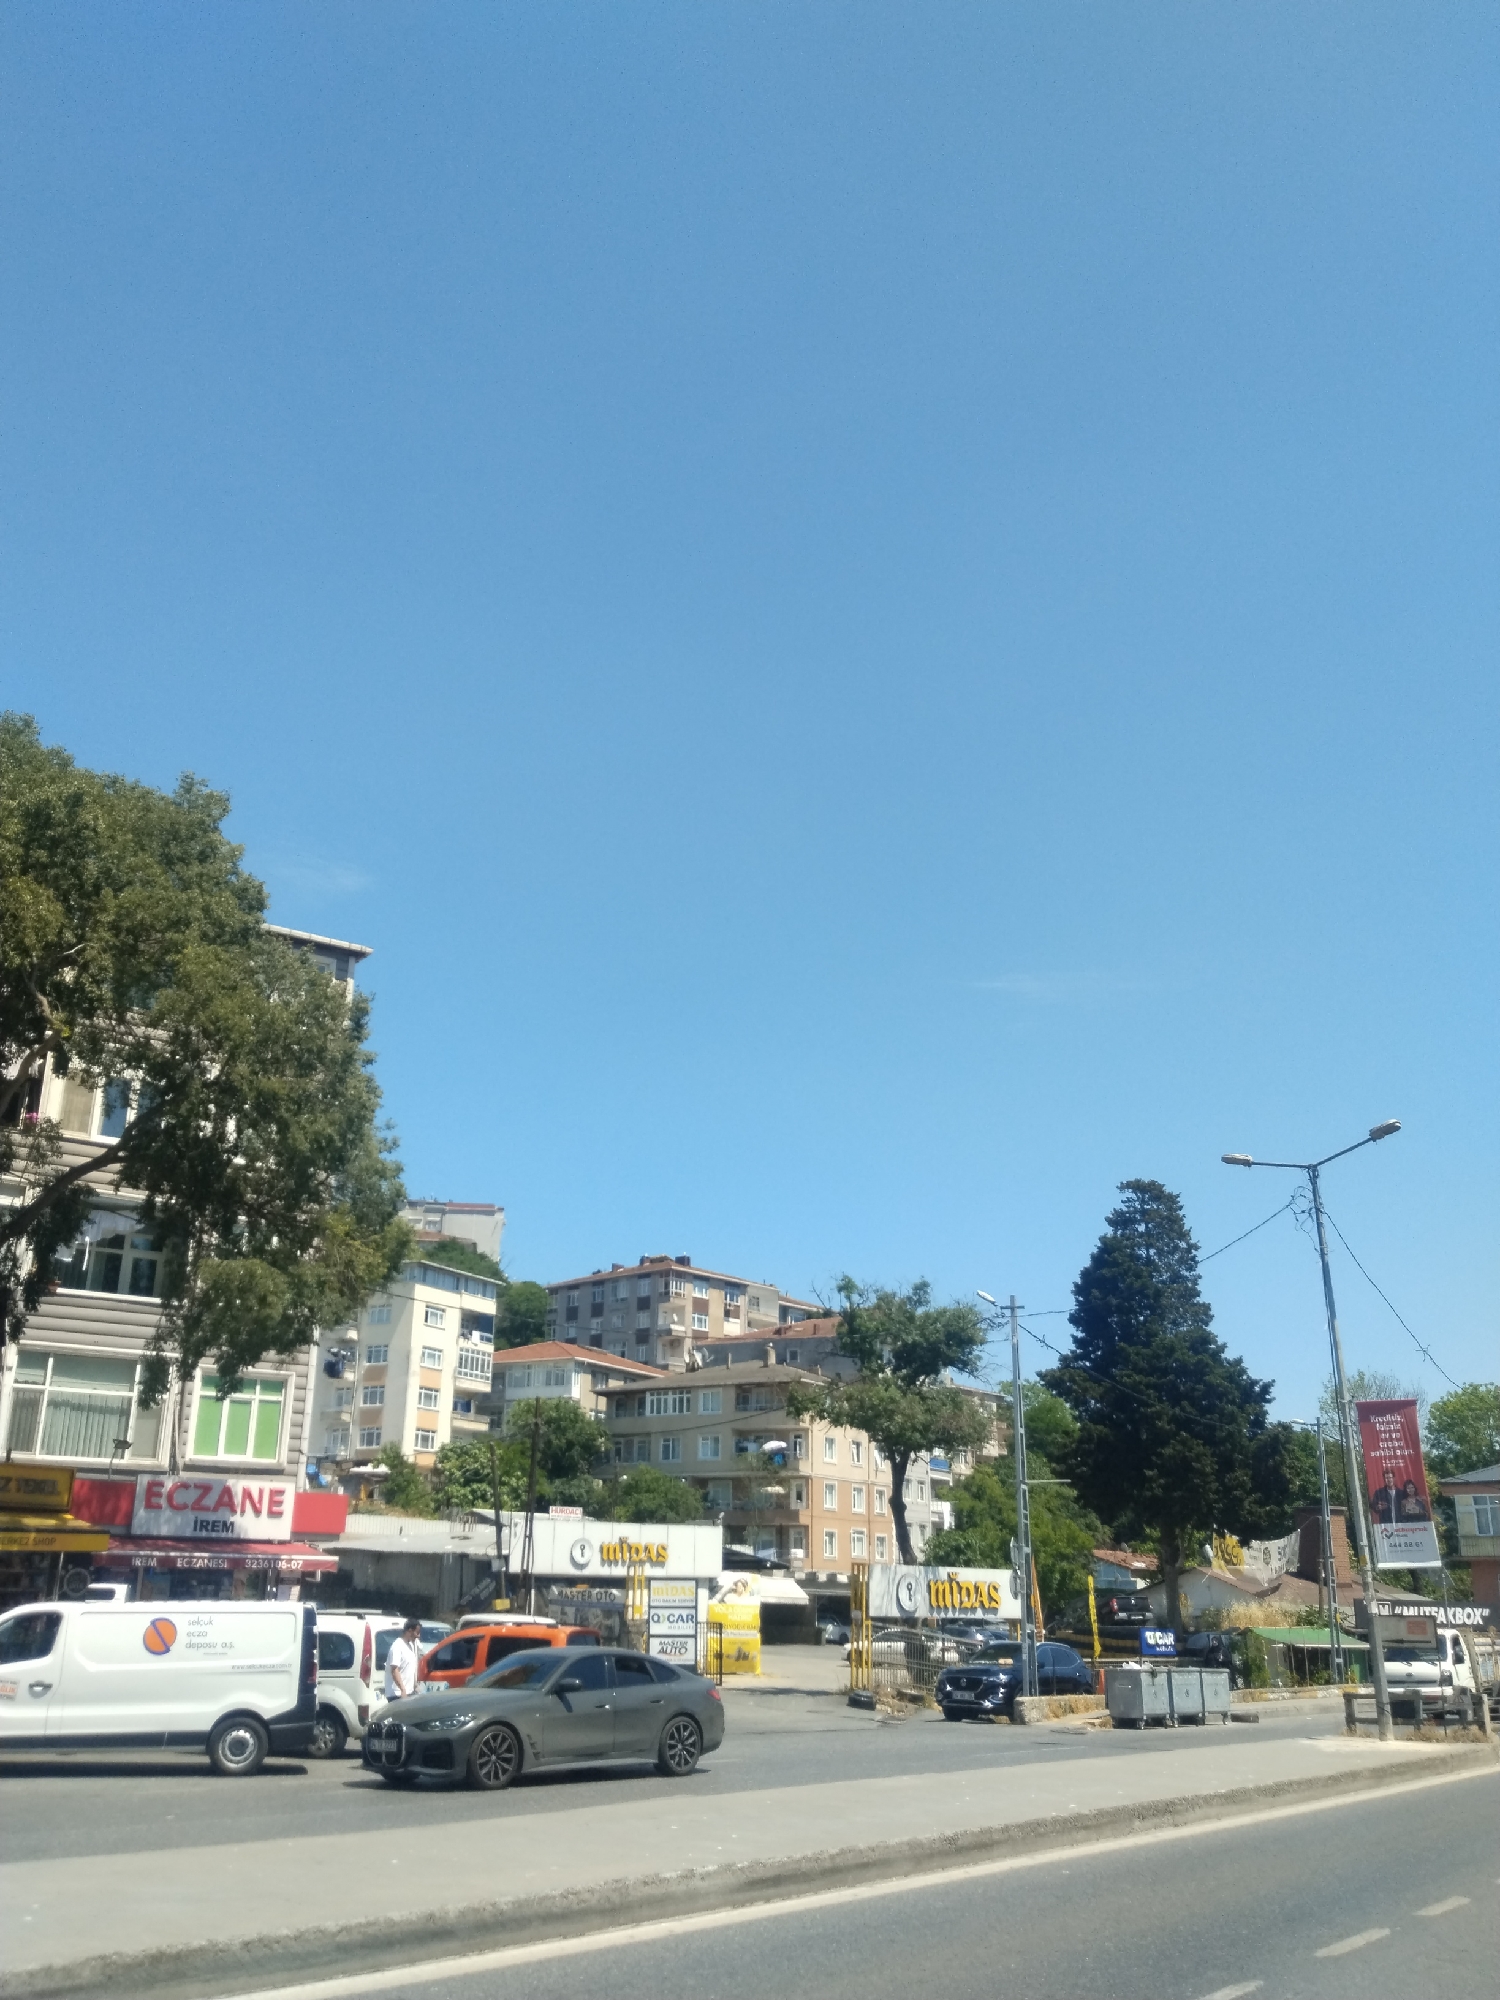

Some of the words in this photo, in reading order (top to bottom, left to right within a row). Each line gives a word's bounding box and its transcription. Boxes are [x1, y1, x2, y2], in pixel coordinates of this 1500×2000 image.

[143, 1480, 286, 1517] ECZANE
[193, 1516, 235, 1534] İREM
[32, 1537, 57, 1546] SHOP
[596, 1590, 616, 1602] OTO
[188, 1616, 214, 1627] selçuk
[185, 1640, 217, 1651] deposu
[657, 1646, 688, 1655] AUTO
